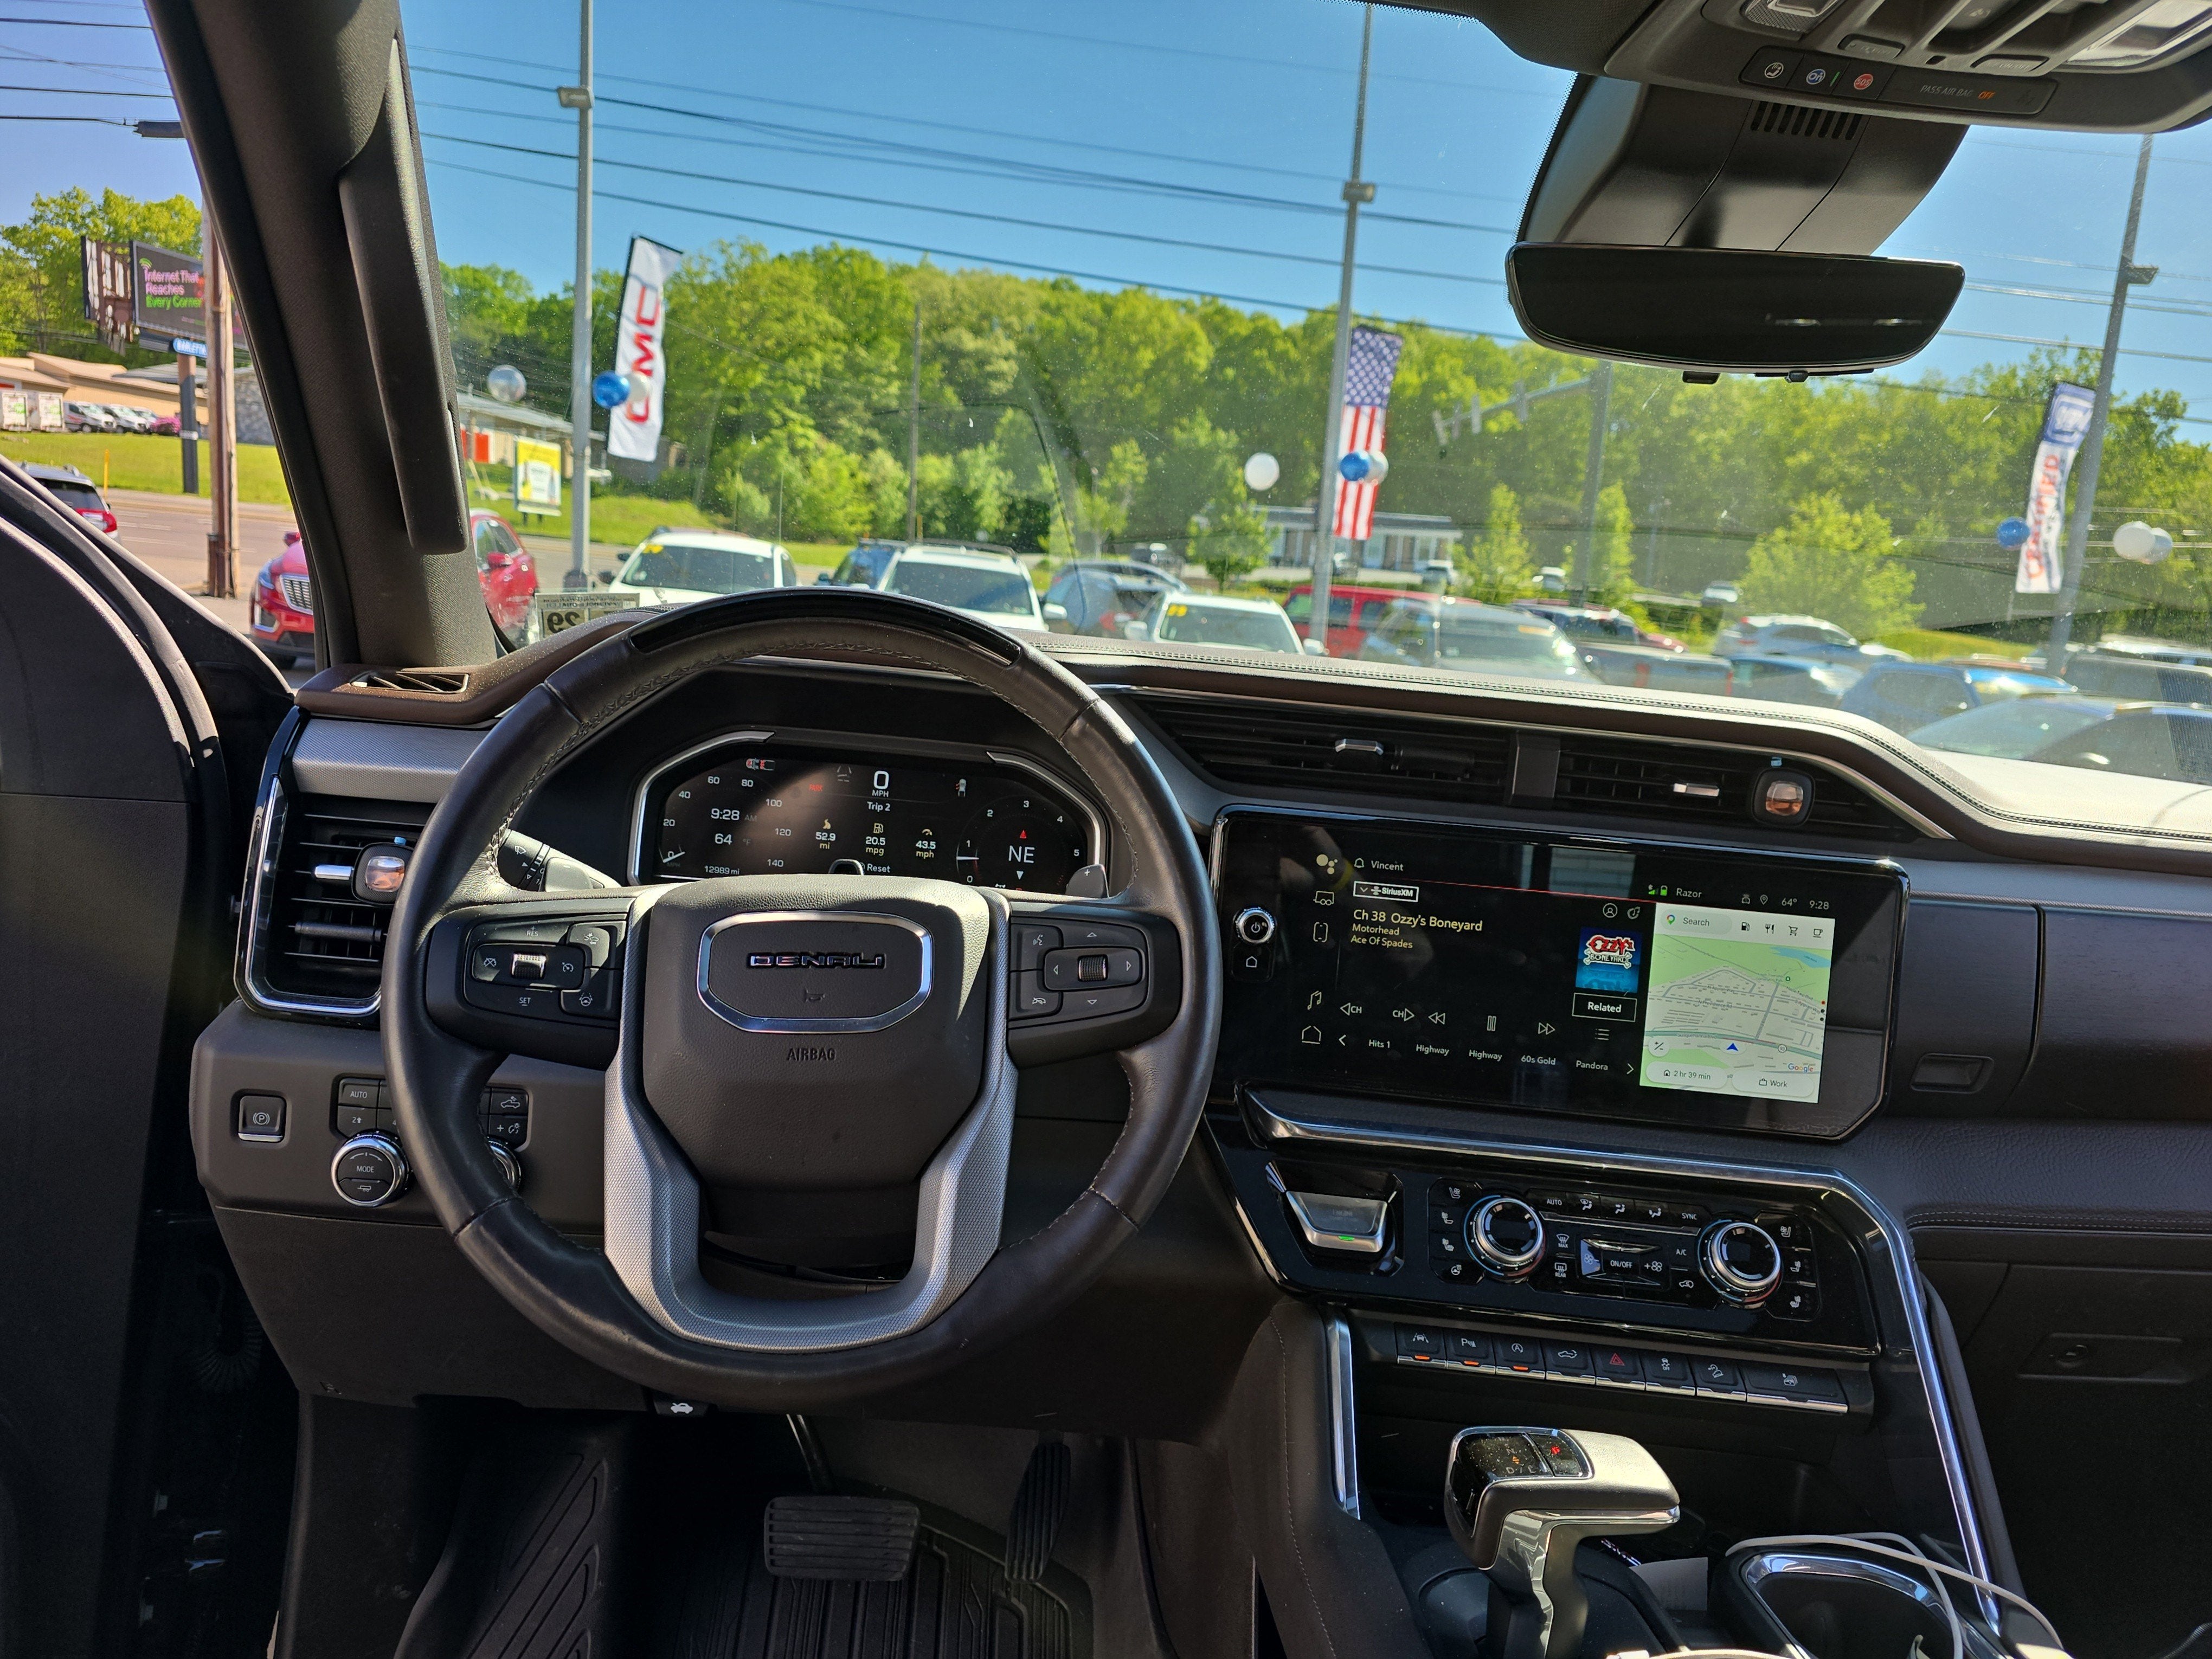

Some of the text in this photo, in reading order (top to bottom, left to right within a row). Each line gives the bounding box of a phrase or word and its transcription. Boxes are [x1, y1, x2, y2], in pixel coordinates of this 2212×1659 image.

[1856, 77, 1871, 87] SOS
[1920, 85, 1996, 100] PASS AIR BAG OFF
[144, 269, 199, 284] Internet That
[145, 282, 185, 295] Reaches
[146, 294, 202, 310] Every Corner
[708, 776, 720, 784] 60
[741, 779, 754, 787] 80
[873, 770, 889, 790] 0
[679, 790, 691, 799] 40
[872, 789, 890, 798] MPH
[766, 799, 782, 807] 100
[867, 801, 891, 812] Trip 2
[1023, 800, 1030, 808] 3
[711, 808, 740, 821] 9:28
[987, 809, 993, 817] 2
[663, 818, 676, 827] 20
[1057, 815, 1063, 824] 4
[775, 828, 792, 837] 120
[815, 831, 836, 841] 52.9
[715, 833, 732, 845] 64
[865, 836, 886, 846] 20.5
[966, 840, 971, 848] 1
[819, 841, 830, 850] mi
[915, 840, 936, 850] 43.5
[866, 846, 884, 857] mpg
[916, 850, 935, 859] mph
[1008, 845, 1036, 864] NE
[1073, 848, 1080, 857] 5
[767, 859, 784, 867] 140
[867, 863, 891, 873] Reset
[1371, 860, 1404, 871] Vincent
[705, 865, 730, 874] 12989
[967, 875, 973, 883] 0
[1381, 886, 1414, 897] SiriusXM
[1676, 888, 1703, 899] Razor
[1809, 901, 1830, 911] 9:28
[1353, 909, 1483, 933] Ch 38 Ozzy's Boneyard
[1683, 917, 1711, 927] Search
[1352, 923, 1400, 936] Motorhead
[1351, 935, 1413, 949] Ace Of Spades
[748, 953, 885, 968] DENALI
[1590, 954, 1627, 963] BONEYARD
[1351, 1006, 1362, 1014] CH
[1587, 1001, 1622, 1013] Related
[1392, 1010, 1404, 1019] CH
[1368, 1039, 1391, 1049] Hits 1
[788, 1047, 836, 1062] AIRBAG
[1416, 1044, 1450, 1057] Highway
[1469, 1050, 1503, 1062] Highway
[1521, 1055, 1556, 1066] 60s Gold
[1576, 1060, 1609, 1071] Pandora
[1787, 1063, 1815, 1073] Google
[1679, 1070, 1687, 1078] hr
[1770, 1079, 1788, 1089] Work
[350, 1091, 368, 1099] AUTO
[356, 1166, 375, 1174] MODE
[1547, 1198, 1562, 1206] AUTO
[1682, 1212, 1697, 1220] SYNC
[1610, 1260, 1633, 1269] ON/OFF
[1461, 1338, 1468, 1347] P
[1506, 1466, 1515, 1474] D
